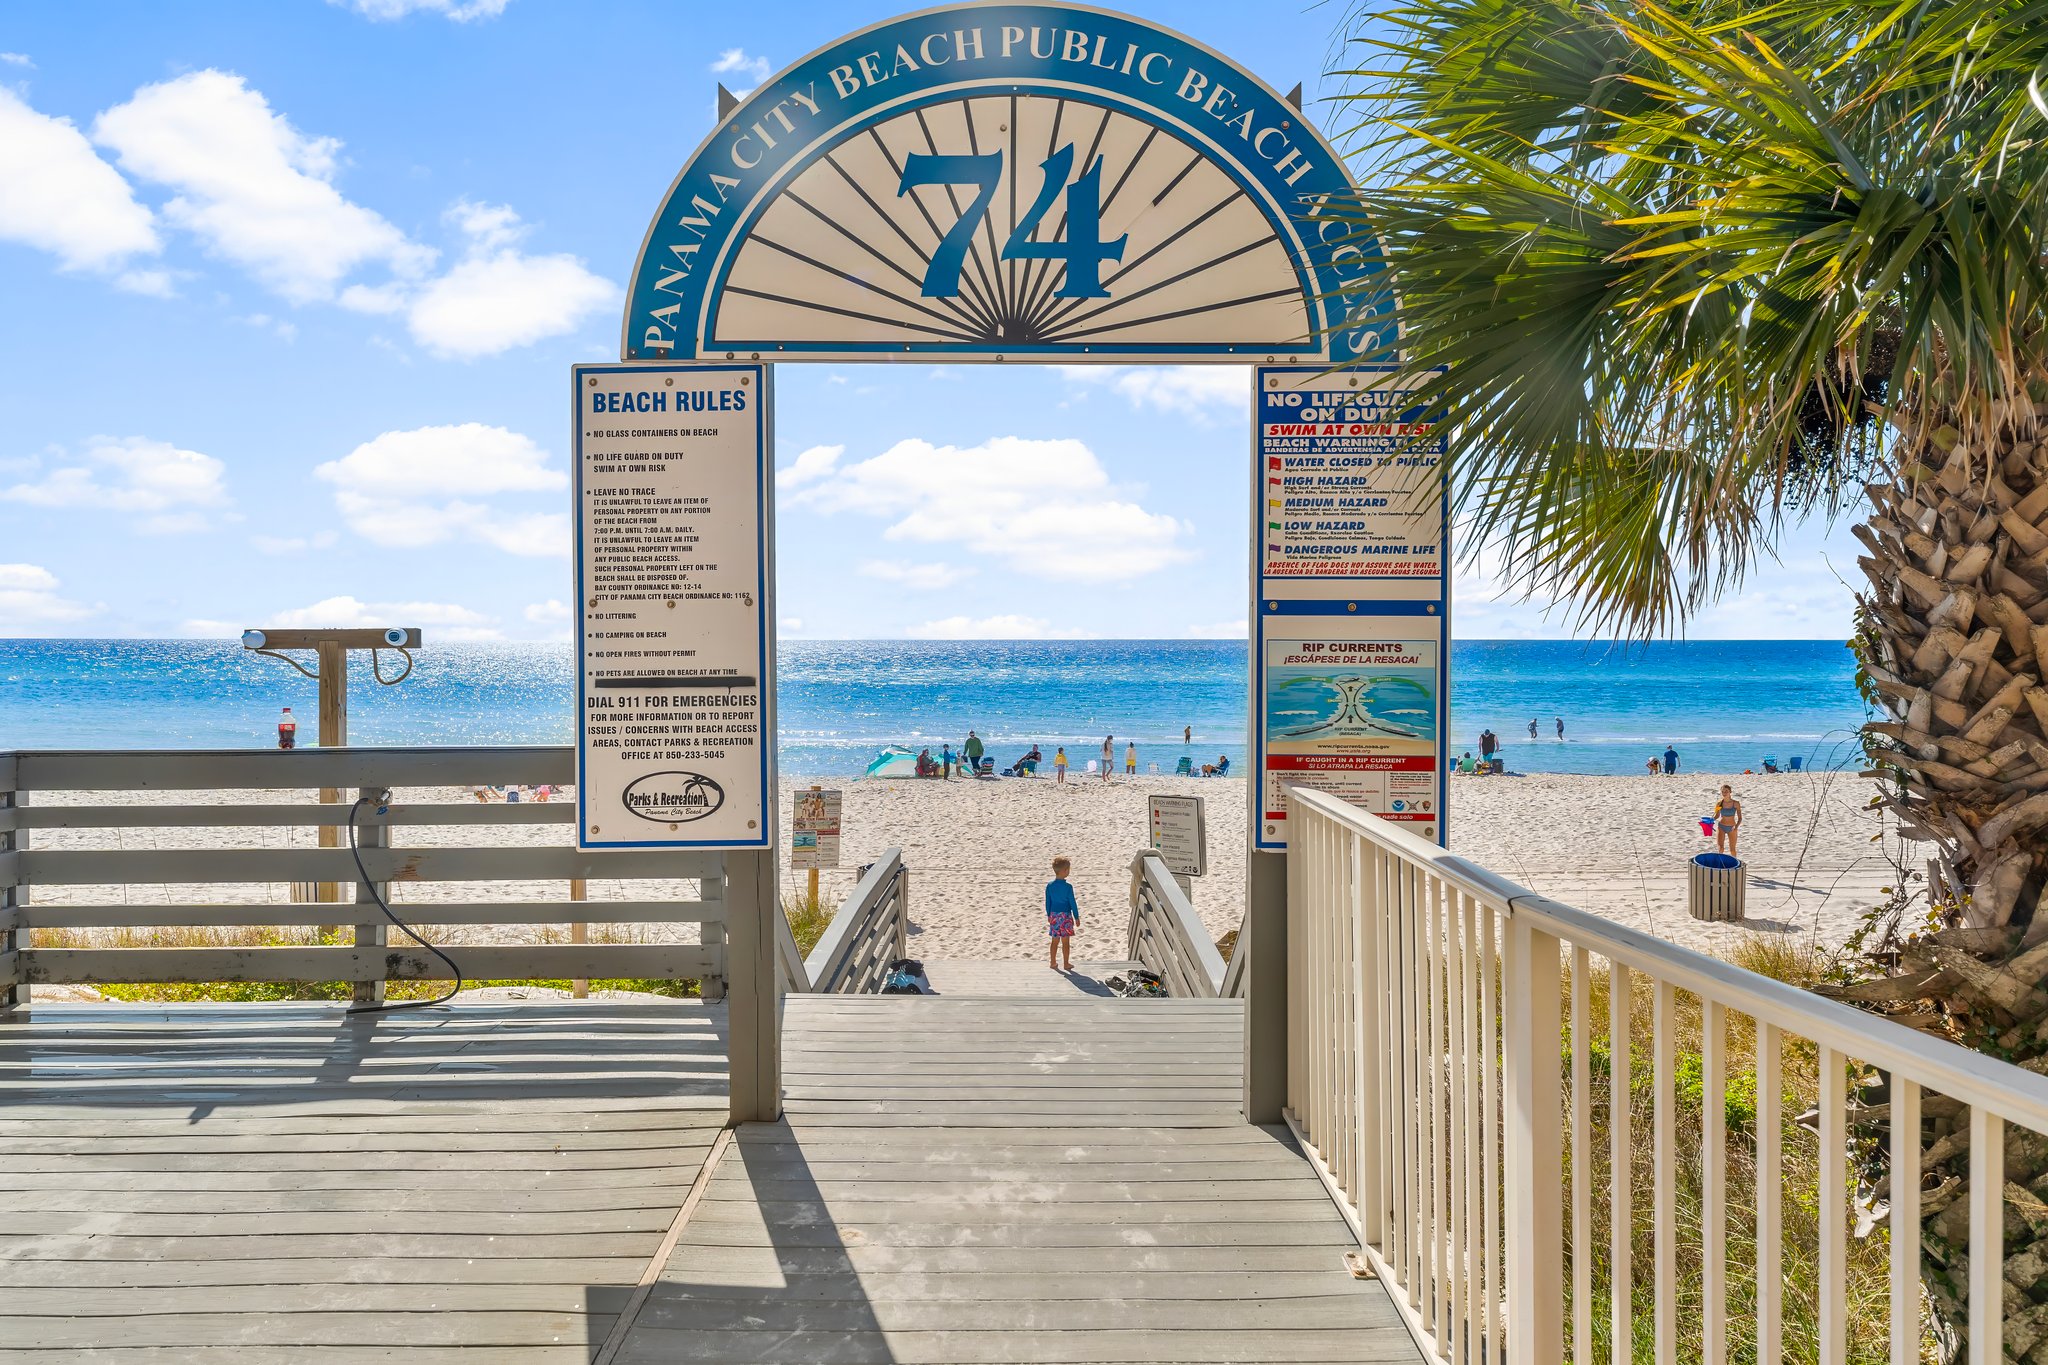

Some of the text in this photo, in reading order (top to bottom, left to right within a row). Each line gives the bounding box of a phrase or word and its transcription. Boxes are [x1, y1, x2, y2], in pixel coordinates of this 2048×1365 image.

[644, 173, 741, 351] PANAMA
[731, 81, 822, 169] CITY
[827, 28, 986, 100] BEACH
[1000, 26, 1172, 85] PUBLIC
[1175, 67, 1313, 187] BEACH
[896, 142, 1129, 298] 74
[593, 391, 745, 413] BEACH RULES
[1267, 394, 1303, 406] NO
[1300, 408, 1335, 422] ON
[594, 430, 604, 438] NO
[606, 430, 629, 438] GLASS
[631, 429, 678, 437] CONTAINERS
[680, 429, 690, 437] ON
[1269, 425, 1317, 435] SWIM
[1323, 425, 1344, 435] AT
[1264, 438, 1310, 447] BEACH
[1315, 438, 1390, 447] WARNING
[594, 453, 604, 461] NO
[606, 453, 622, 461] LIFE
[624, 453, 649, 461] GUARD
[665, 452, 683, 460] DUTY
[1284, 458, 1325, 466] WATER
[1329, 458, 1373, 466] CLOSED
[594, 465, 615, 473] SWIM
[649, 464, 665, 472] RISK
[1283, 476, 1366, 485] HIGH HAZARD
[594, 488, 655, 496] LEAVE NO TRACE
[1285, 498, 1388, 507] MEDIUM HAZARD
[1284, 522, 1365, 530] LOW HAZARD
[1284, 545, 1436, 554] DANGEROUS MARINE LIFE
[685, 592, 720, 600] ORDINANCE
[1302, 643, 1403, 652] RIP CURRENTS
[1284, 654, 1340, 665] ¡ESCÁPESE
[1359, 656, 1372, 664] LA
[709, 668, 721, 676] ANY
[588, 694, 757, 709] DIAL 911 FOR EMERGENCIES
[591, 711, 754, 722] FOR MORE INFORMATION OR TO REPORT
[588, 726, 616, 735] ISSUES
[625, 725, 669, 734] CONCERNS
[672, 725, 693, 734] WITH
[696, 725, 723, 734] BEACH
[726, 724, 757, 733] ACCESS
[593, 739, 621, 748] AREAS,
[625, 738, 662, 747] CONTACT
[665, 738, 691, 747] PARKS
[703, 737, 753, 746] RECREATION
[622, 751, 725, 760] OFFICE AT 850-233-5045
[629, 792, 703, 806] Parks & Recreation
[645, 808, 668, 816] Panama
[671, 808, 683, 816] City
